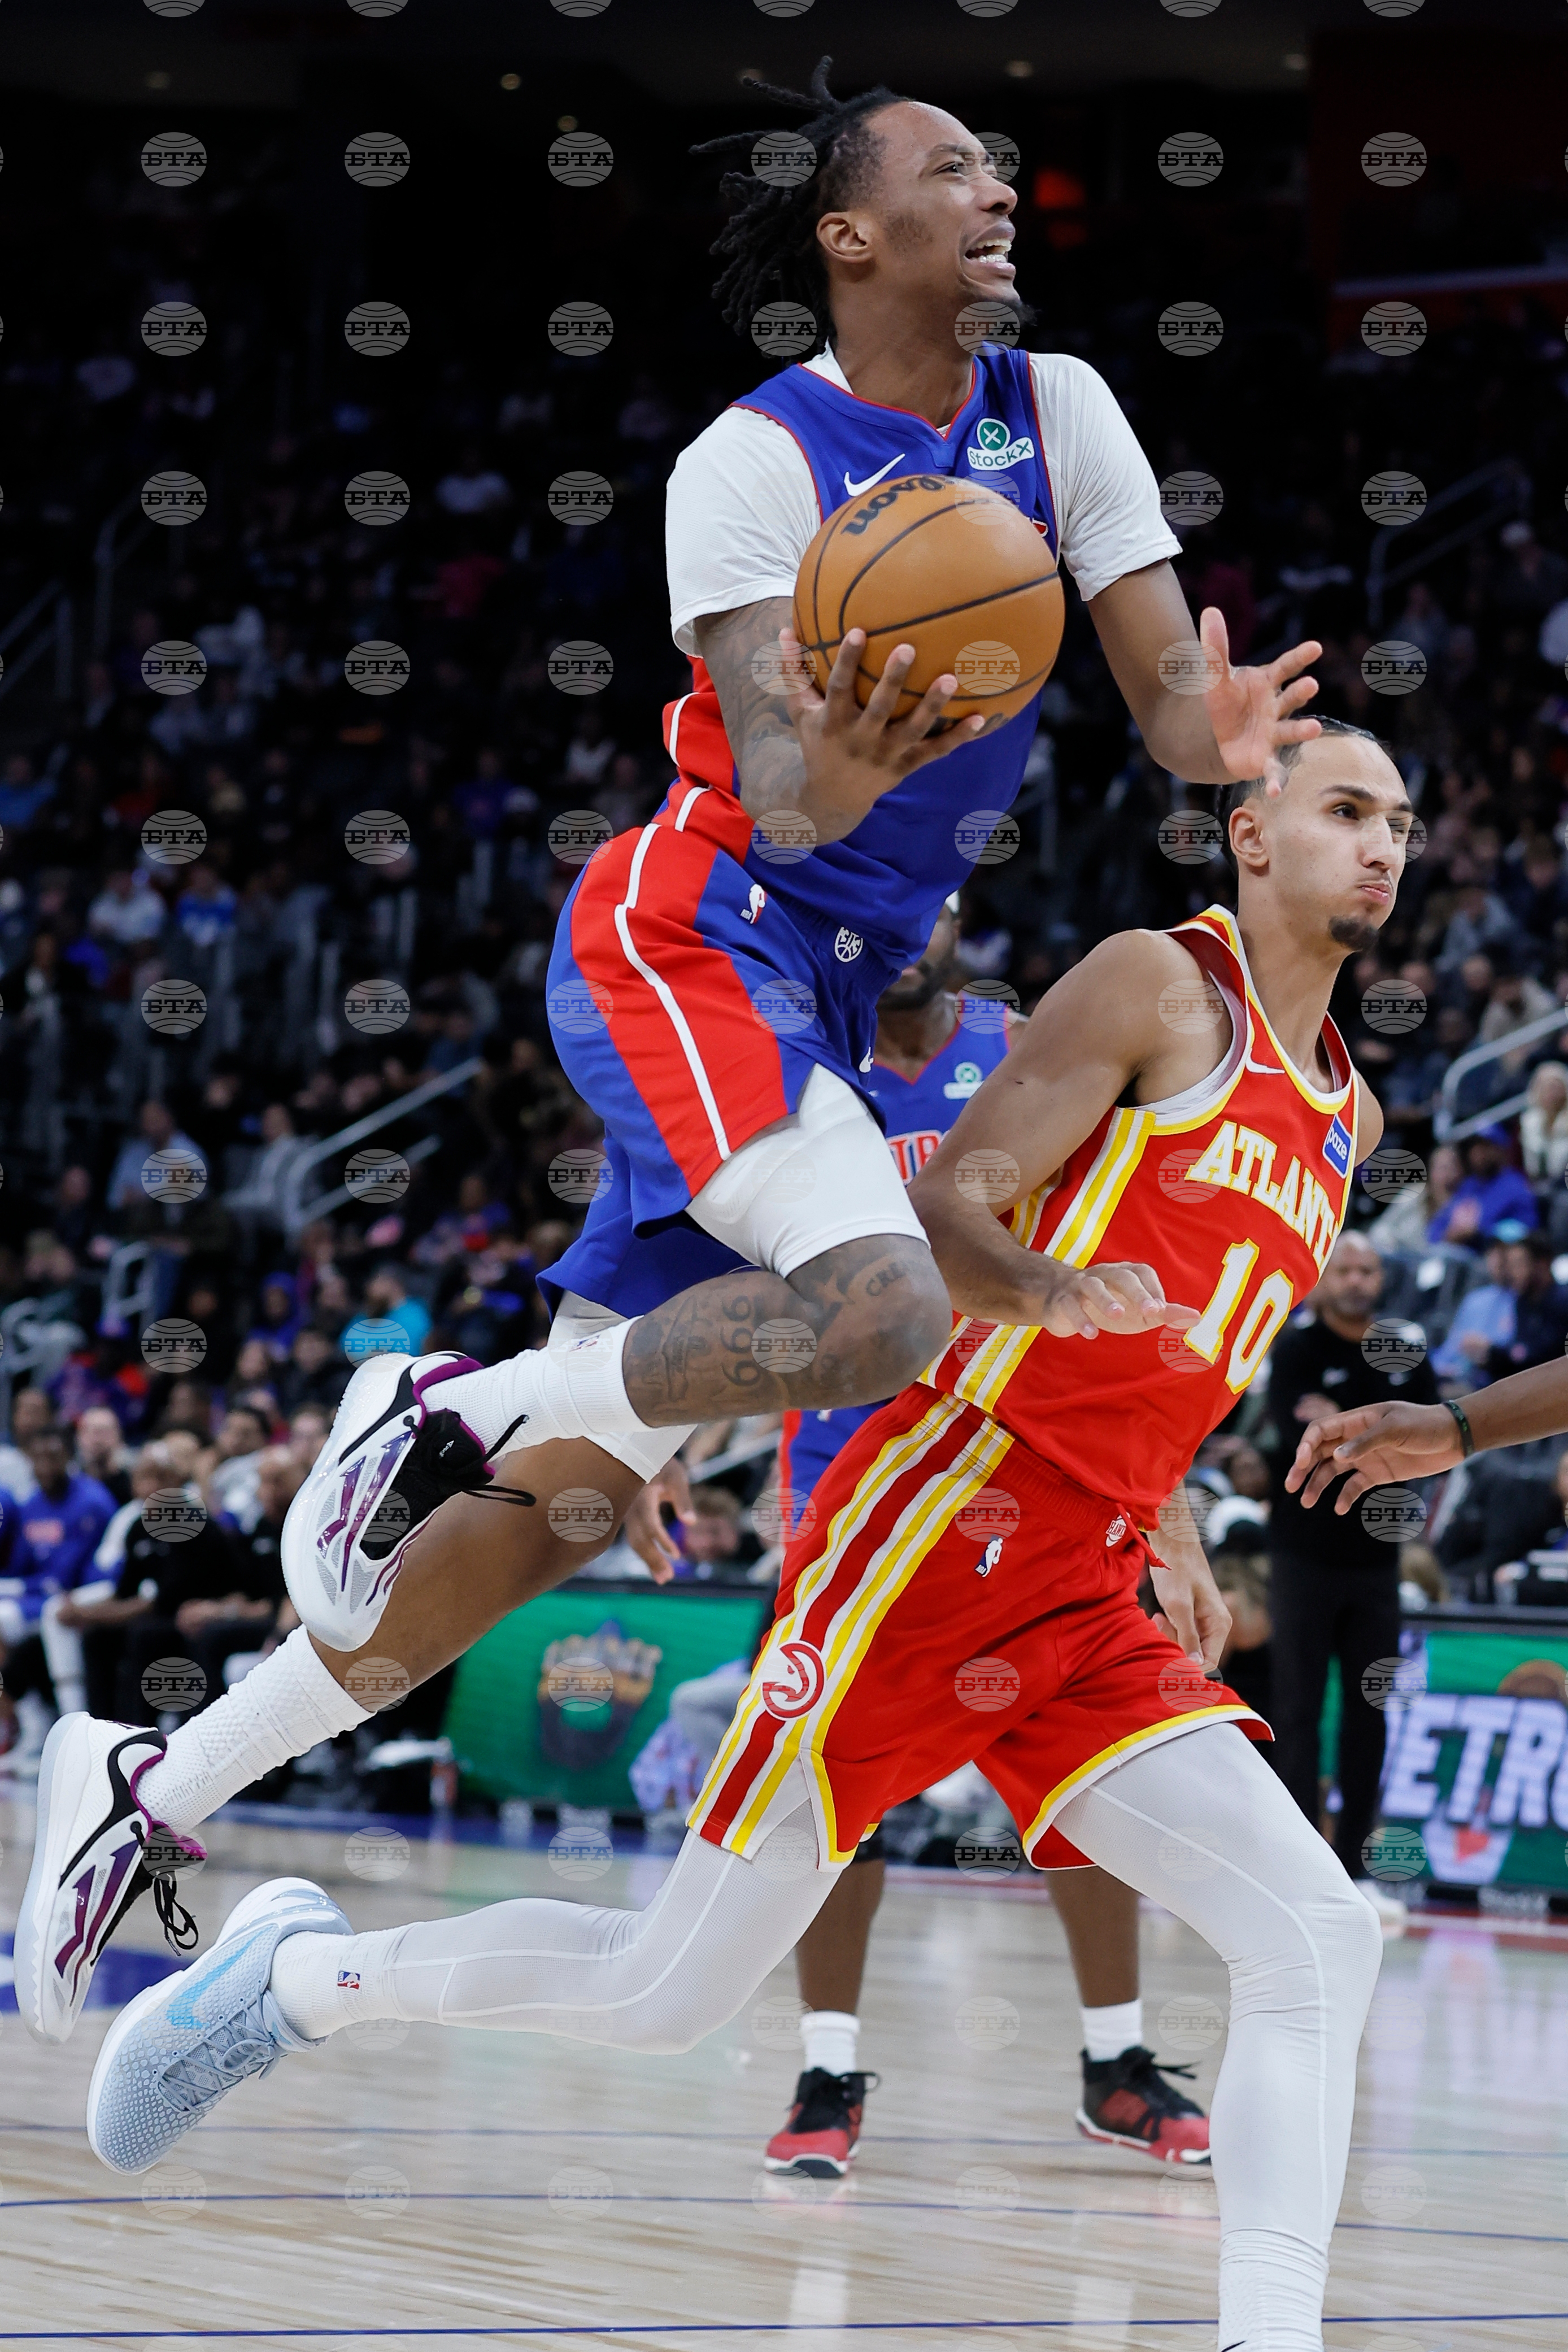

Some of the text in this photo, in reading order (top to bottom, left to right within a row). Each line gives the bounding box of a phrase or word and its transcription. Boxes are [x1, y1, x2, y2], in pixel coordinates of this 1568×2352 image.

[969, 441, 1033, 467] StockX
[1184, 1120, 1341, 1274] ATLANT
[1326, 1125, 1347, 1161] paze
[1182, 1238, 1294, 1395] 10
[1378, 1693, 1568, 1831] ETR
